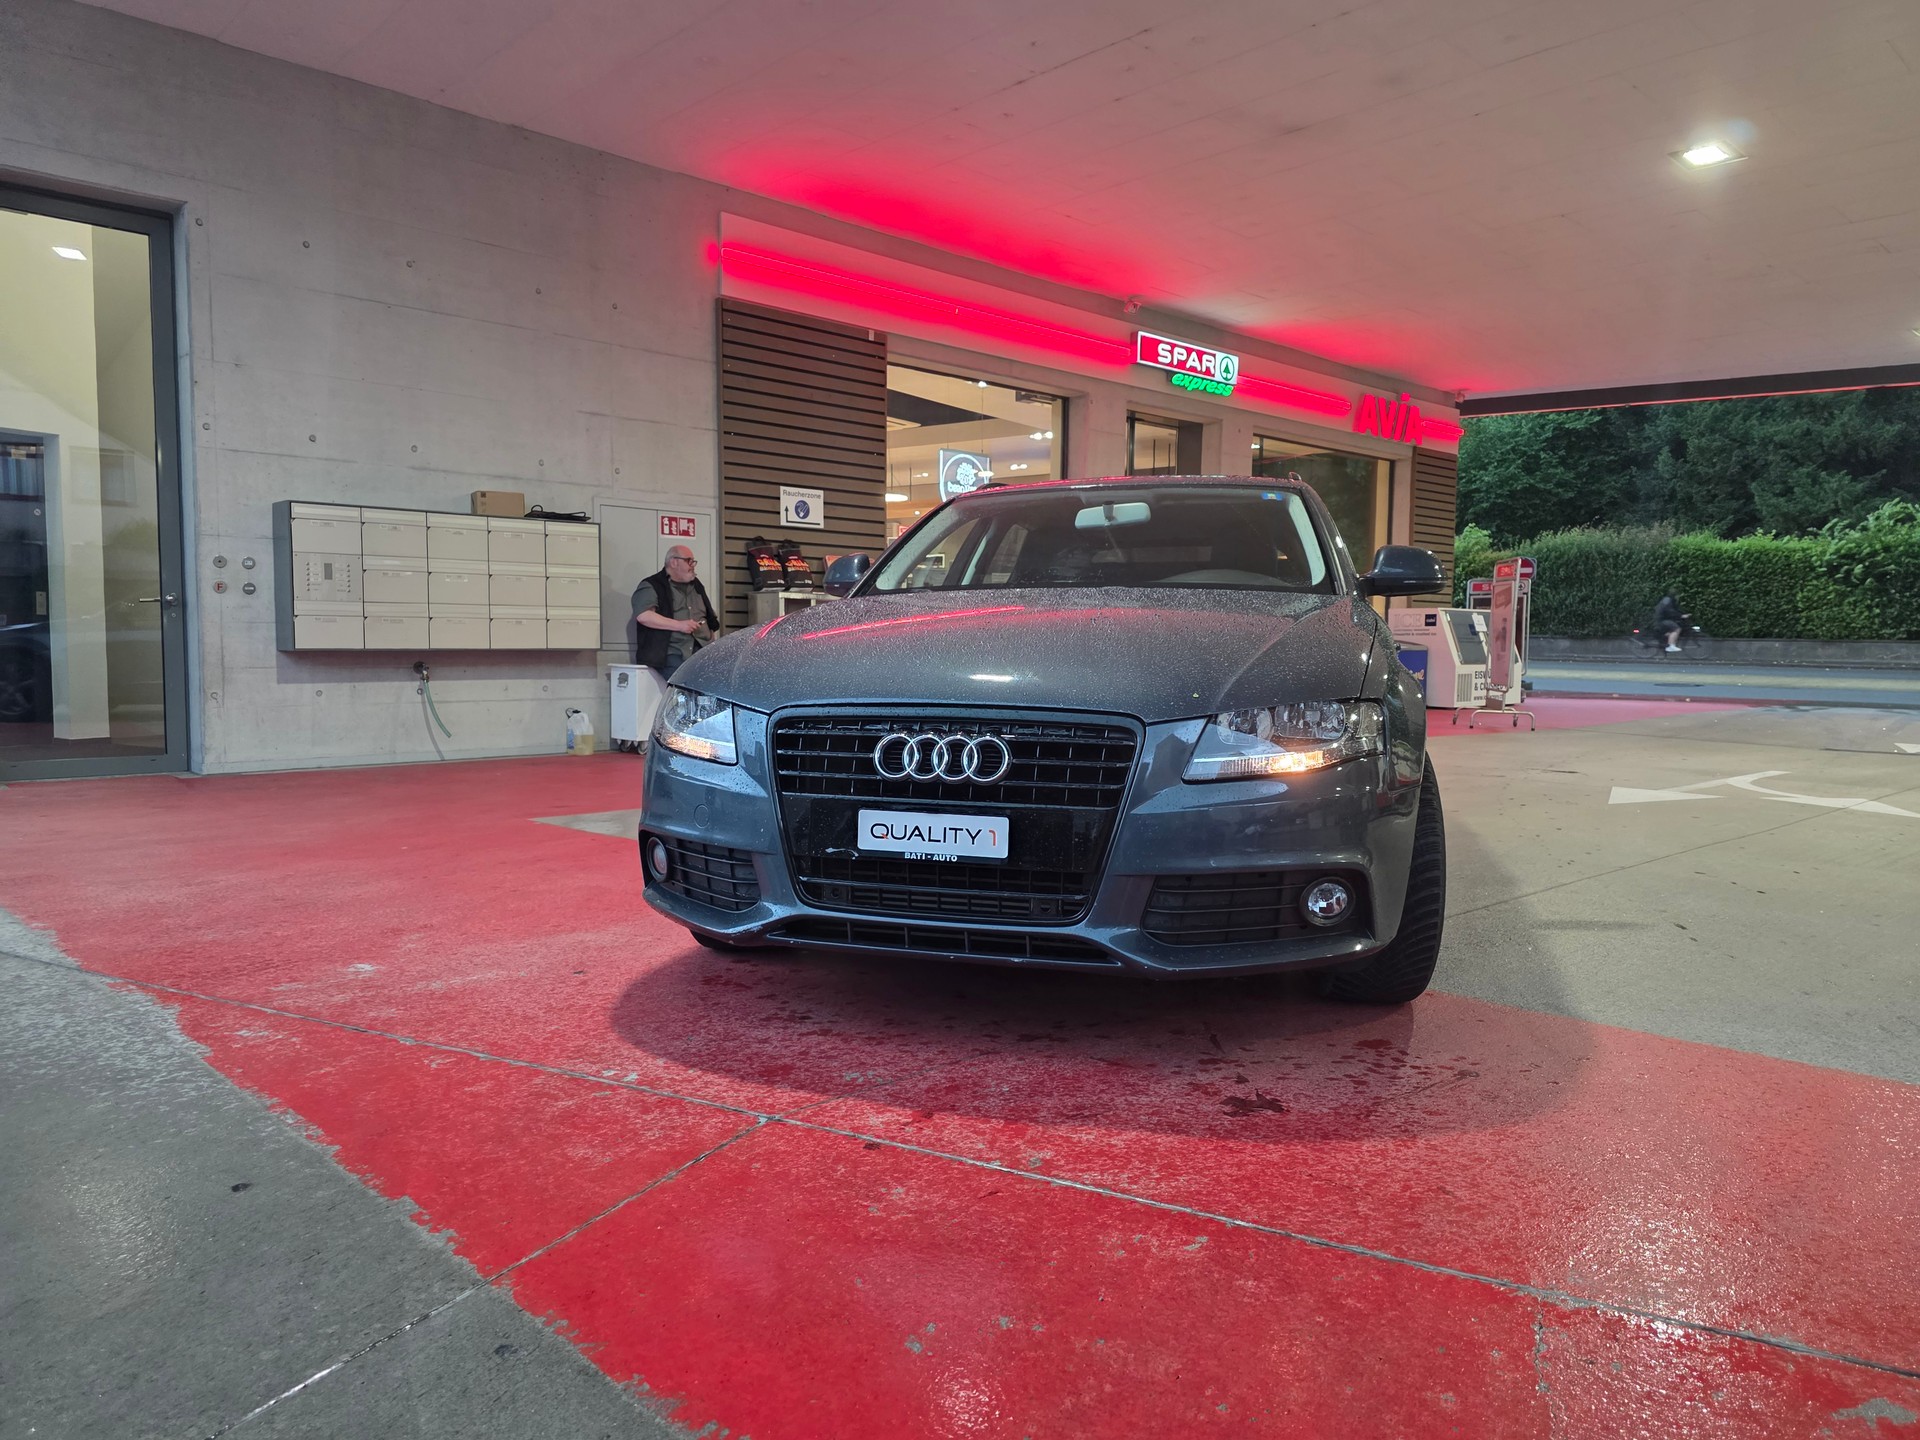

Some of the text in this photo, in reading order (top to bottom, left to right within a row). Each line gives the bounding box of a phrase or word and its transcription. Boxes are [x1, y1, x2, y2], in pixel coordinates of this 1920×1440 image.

[1157, 343, 1215, 375] SPAR
[1171, 373, 1234, 397] express
[782, 490, 822, 499] Raucherzone
[870, 823, 996, 846] QUALITY 1
